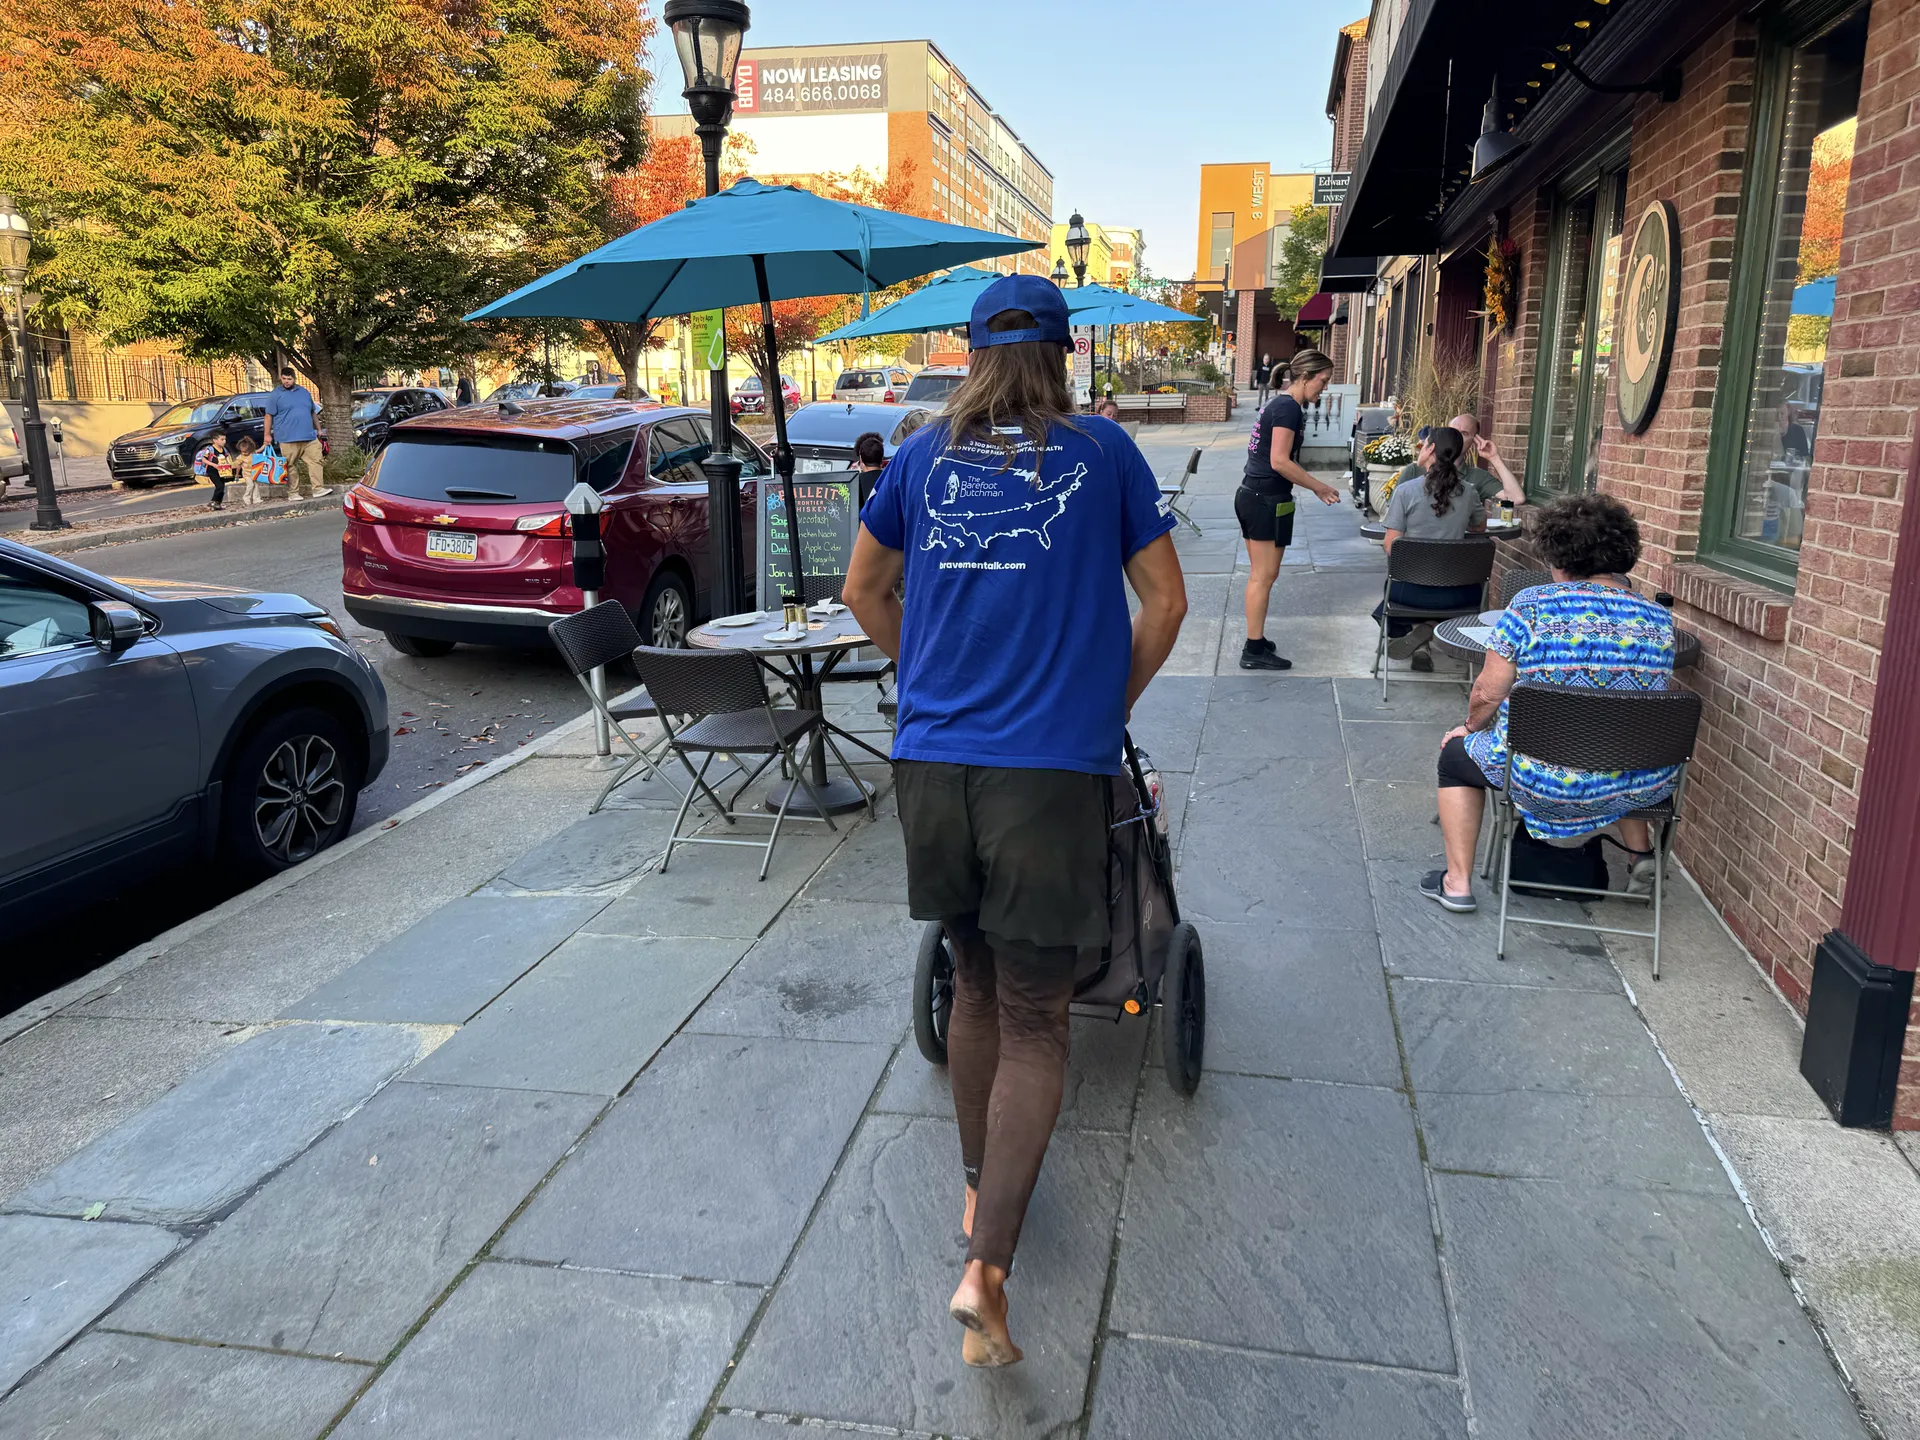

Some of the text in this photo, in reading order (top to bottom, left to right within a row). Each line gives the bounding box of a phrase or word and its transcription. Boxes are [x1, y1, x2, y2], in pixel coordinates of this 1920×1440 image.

[762, 64, 882, 85] NOW LEASING
[738, 65, 753, 108] BOYD
[763, 84, 881, 103] 484.666.0068
[1318, 176, 1350, 186] Edward
[1251, 169, 1265, 209] WEST
[961, 480, 998, 490] Barefoot
[960, 489, 1004, 498] Dutchman
[796, 505, 827, 513] HISKEY
[768, 563, 786, 577] Join
[939, 561, 1026, 570] bravementalk.com
